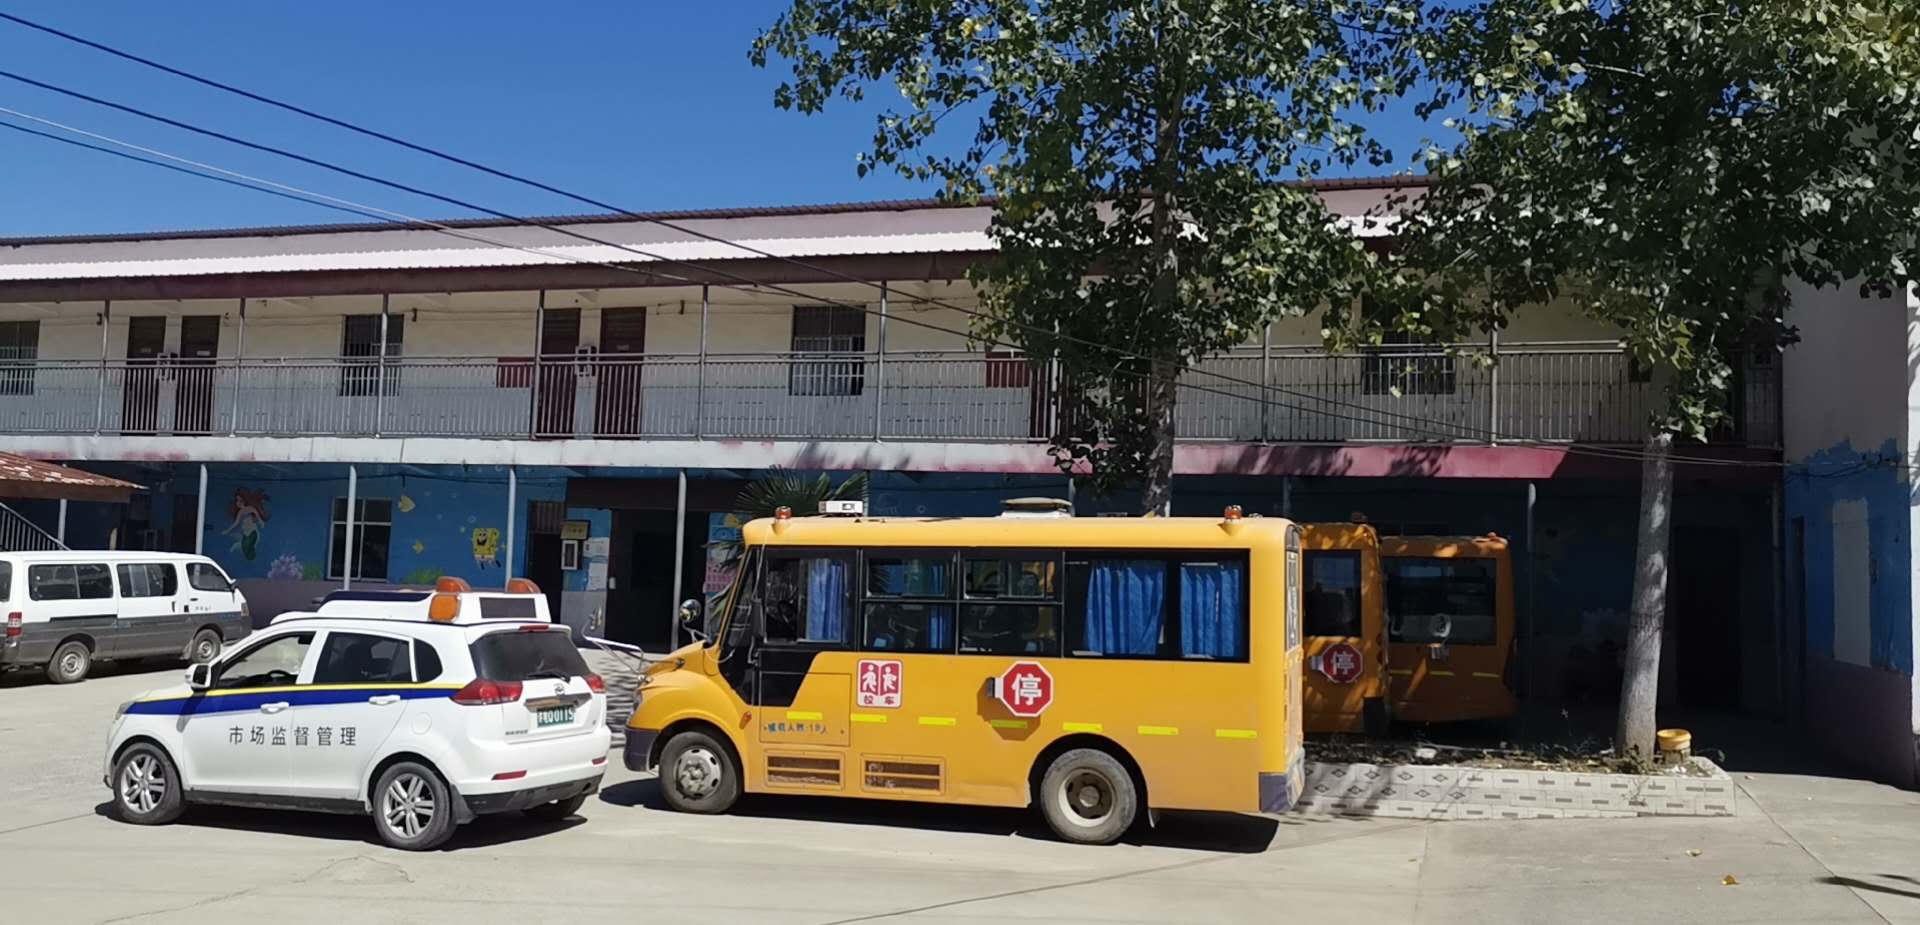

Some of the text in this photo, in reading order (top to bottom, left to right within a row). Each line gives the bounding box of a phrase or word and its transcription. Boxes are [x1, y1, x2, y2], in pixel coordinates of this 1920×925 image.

[1330, 651, 1354, 675] 停
[1011, 673, 1042, 706] 停
[229, 725, 357, 746] 市场监督管理
